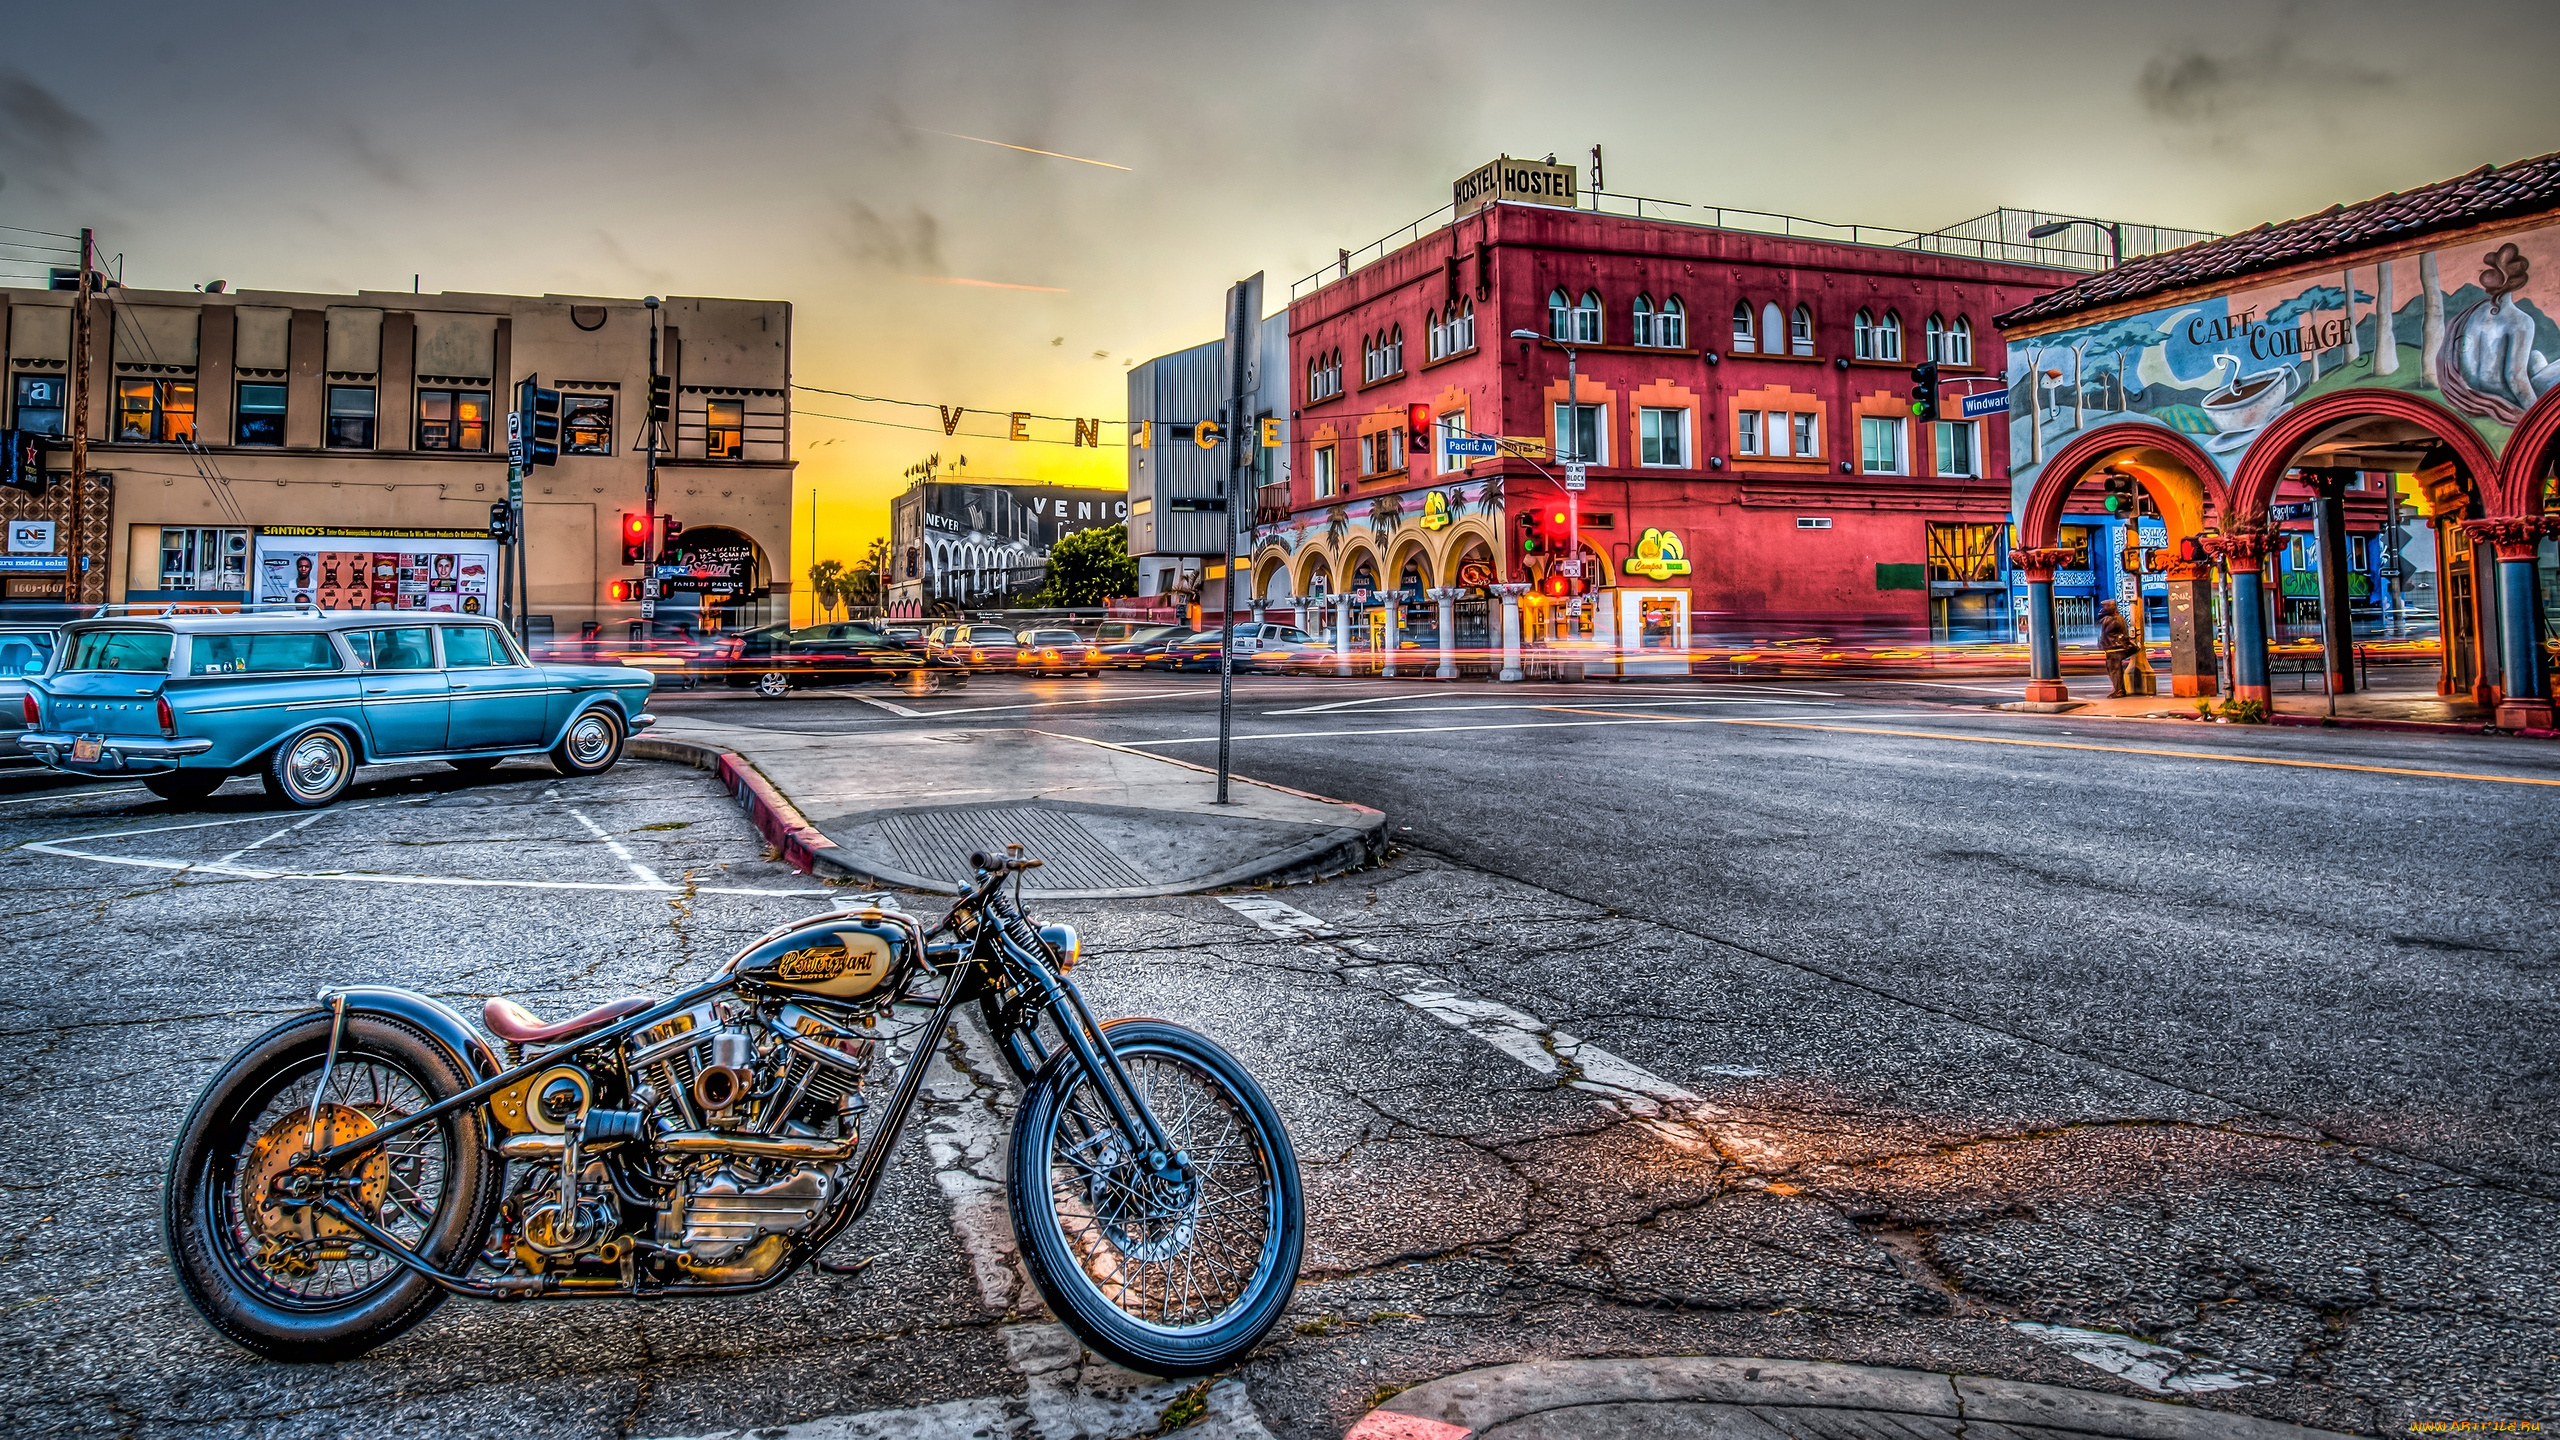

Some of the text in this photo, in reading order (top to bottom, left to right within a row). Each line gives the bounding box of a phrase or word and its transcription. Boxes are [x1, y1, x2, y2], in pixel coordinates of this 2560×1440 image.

[1455, 166, 1496, 206] HOSTEL
[1504, 168, 1575, 198] HOSTEL
[2187, 304, 2353, 361] CAFÉ COLLAGE
[30, 382, 51, 401] a
[939, 404, 1283, 450] VENICE
[1450, 440, 1493, 453] Pacific Av
[1033, 496, 1128, 520] VENIC
[2272, 503, 2311, 516] Pacific Av
[263, 526, 326, 536] SANTINO'S
[926, 512, 960, 532] NEVER
[16, 529, 46, 540] ONE
[1634, 560, 1662, 571] Campos
[55, 702, 143, 711] RAMBLER
[780, 950, 877, 978] Powerplant
[1187, 1335, 1216, 1348] AVON
